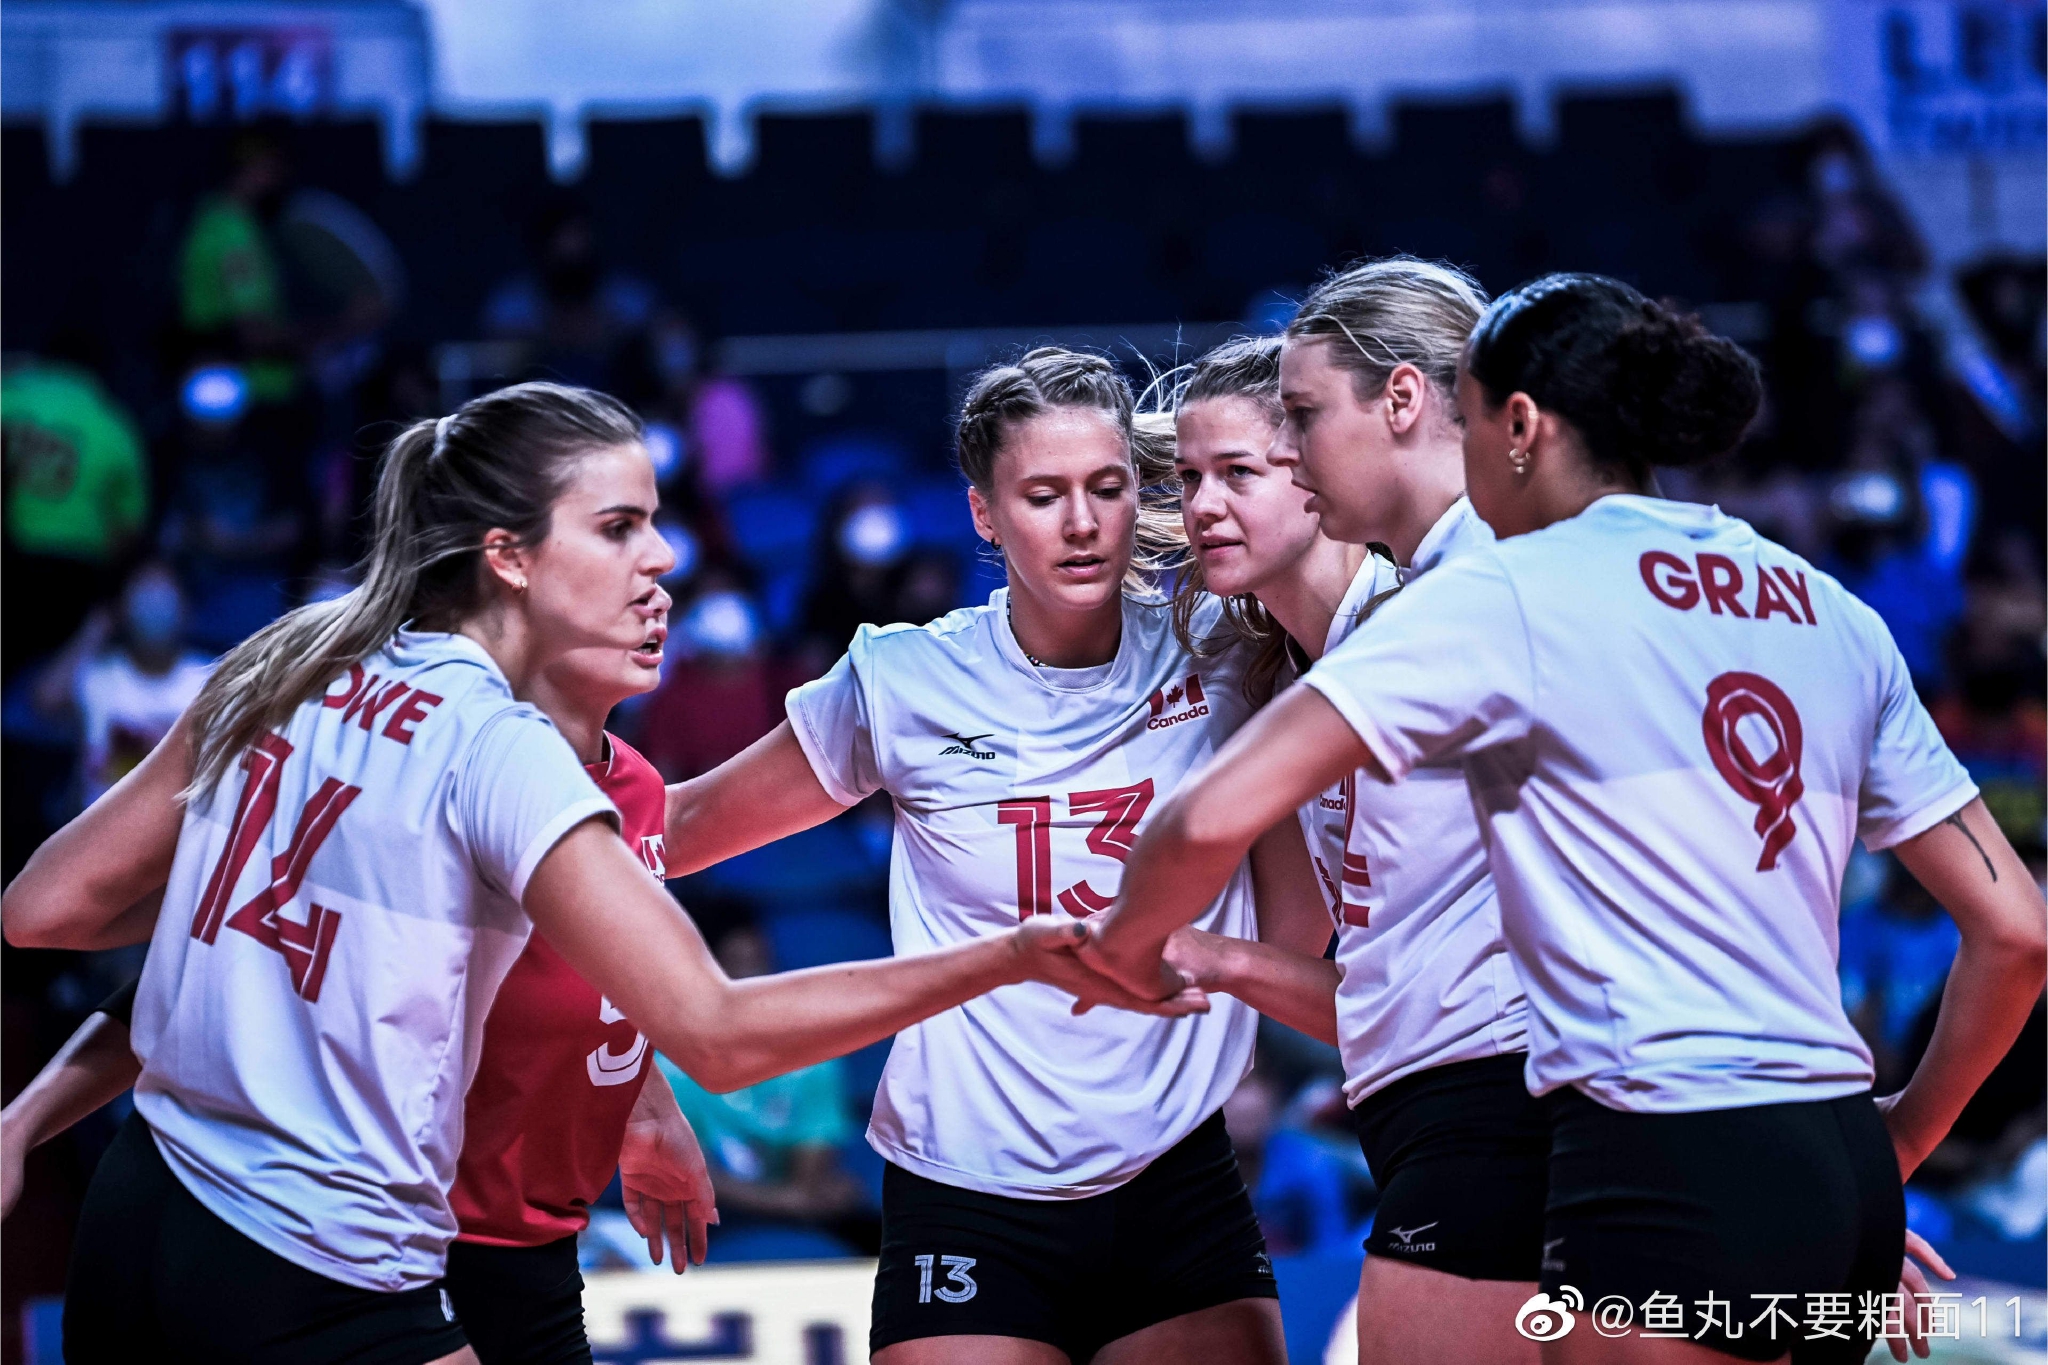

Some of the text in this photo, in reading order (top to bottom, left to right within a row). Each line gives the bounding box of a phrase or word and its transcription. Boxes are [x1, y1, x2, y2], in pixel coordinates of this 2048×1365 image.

[1639, 550, 1817, 626] GRAY
[322, 661, 443, 746] OWE
[1147, 704, 1209, 730] Canada
[1702, 671, 1804, 872] 9
[190, 731, 362, 1003] 14
[997, 777, 1155, 922] 13
[914, 1254, 978, 1303] 13
